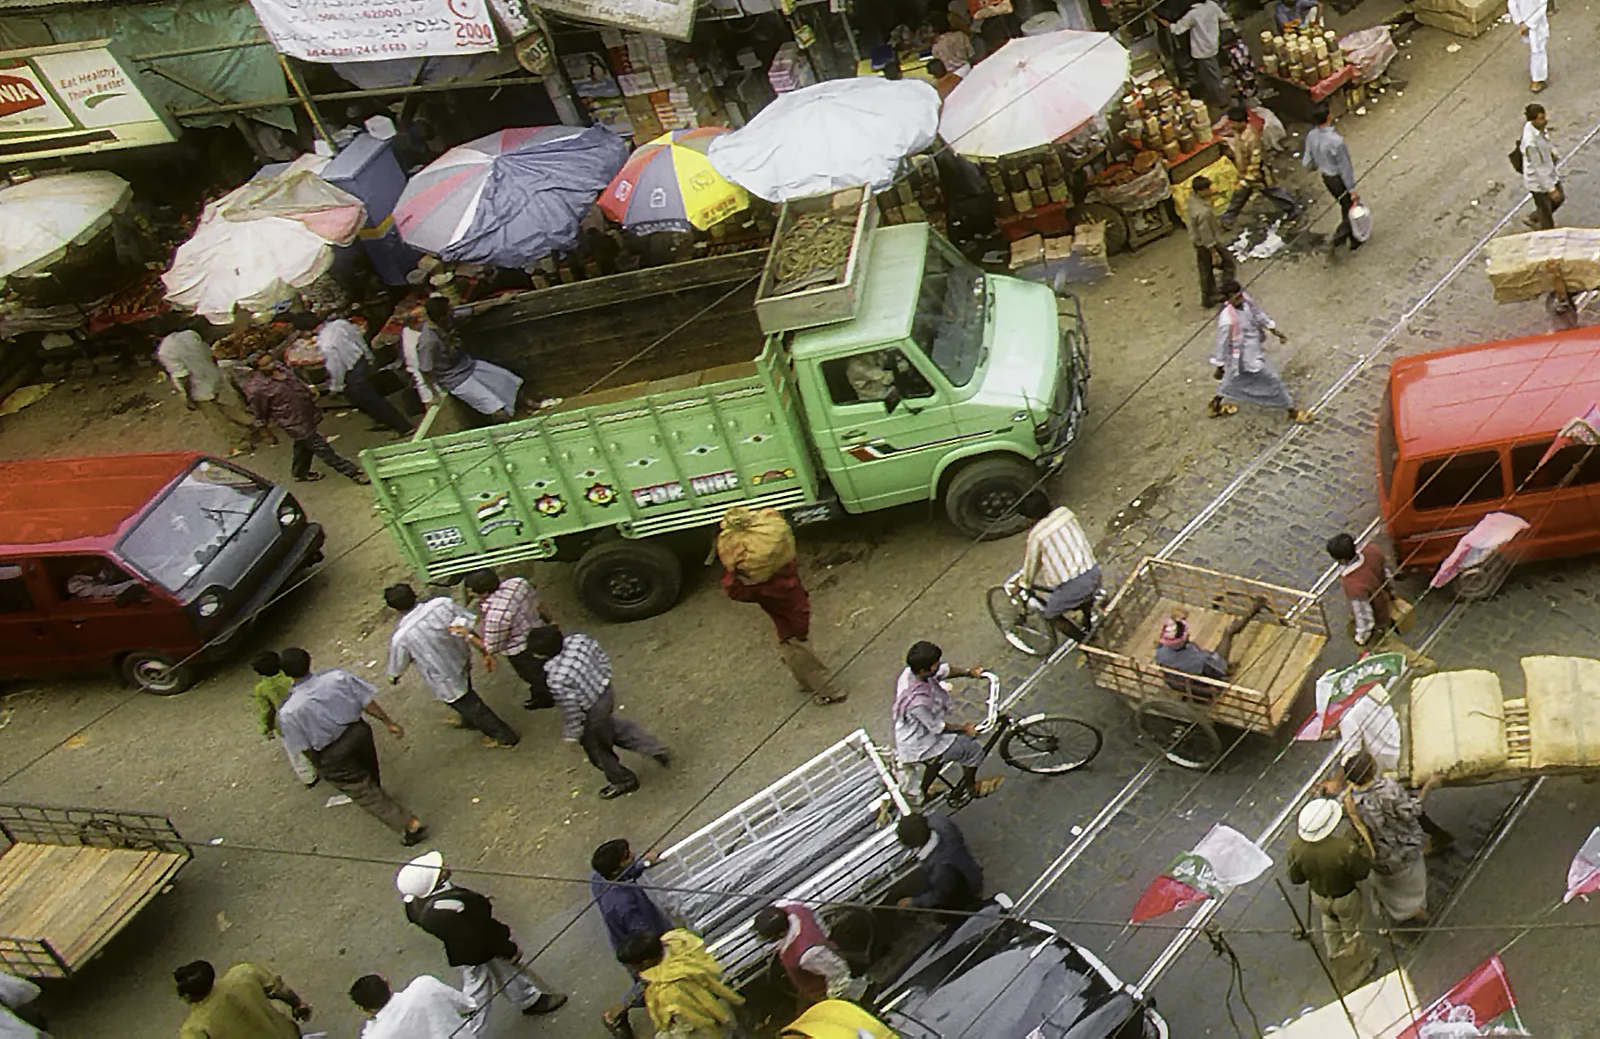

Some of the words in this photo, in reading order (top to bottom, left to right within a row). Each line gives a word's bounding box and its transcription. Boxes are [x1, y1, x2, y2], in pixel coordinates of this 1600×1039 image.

[455, 20, 491, 39] 2000
[633, 482, 686, 508] FOR
[690, 470, 740, 496] HIRE
